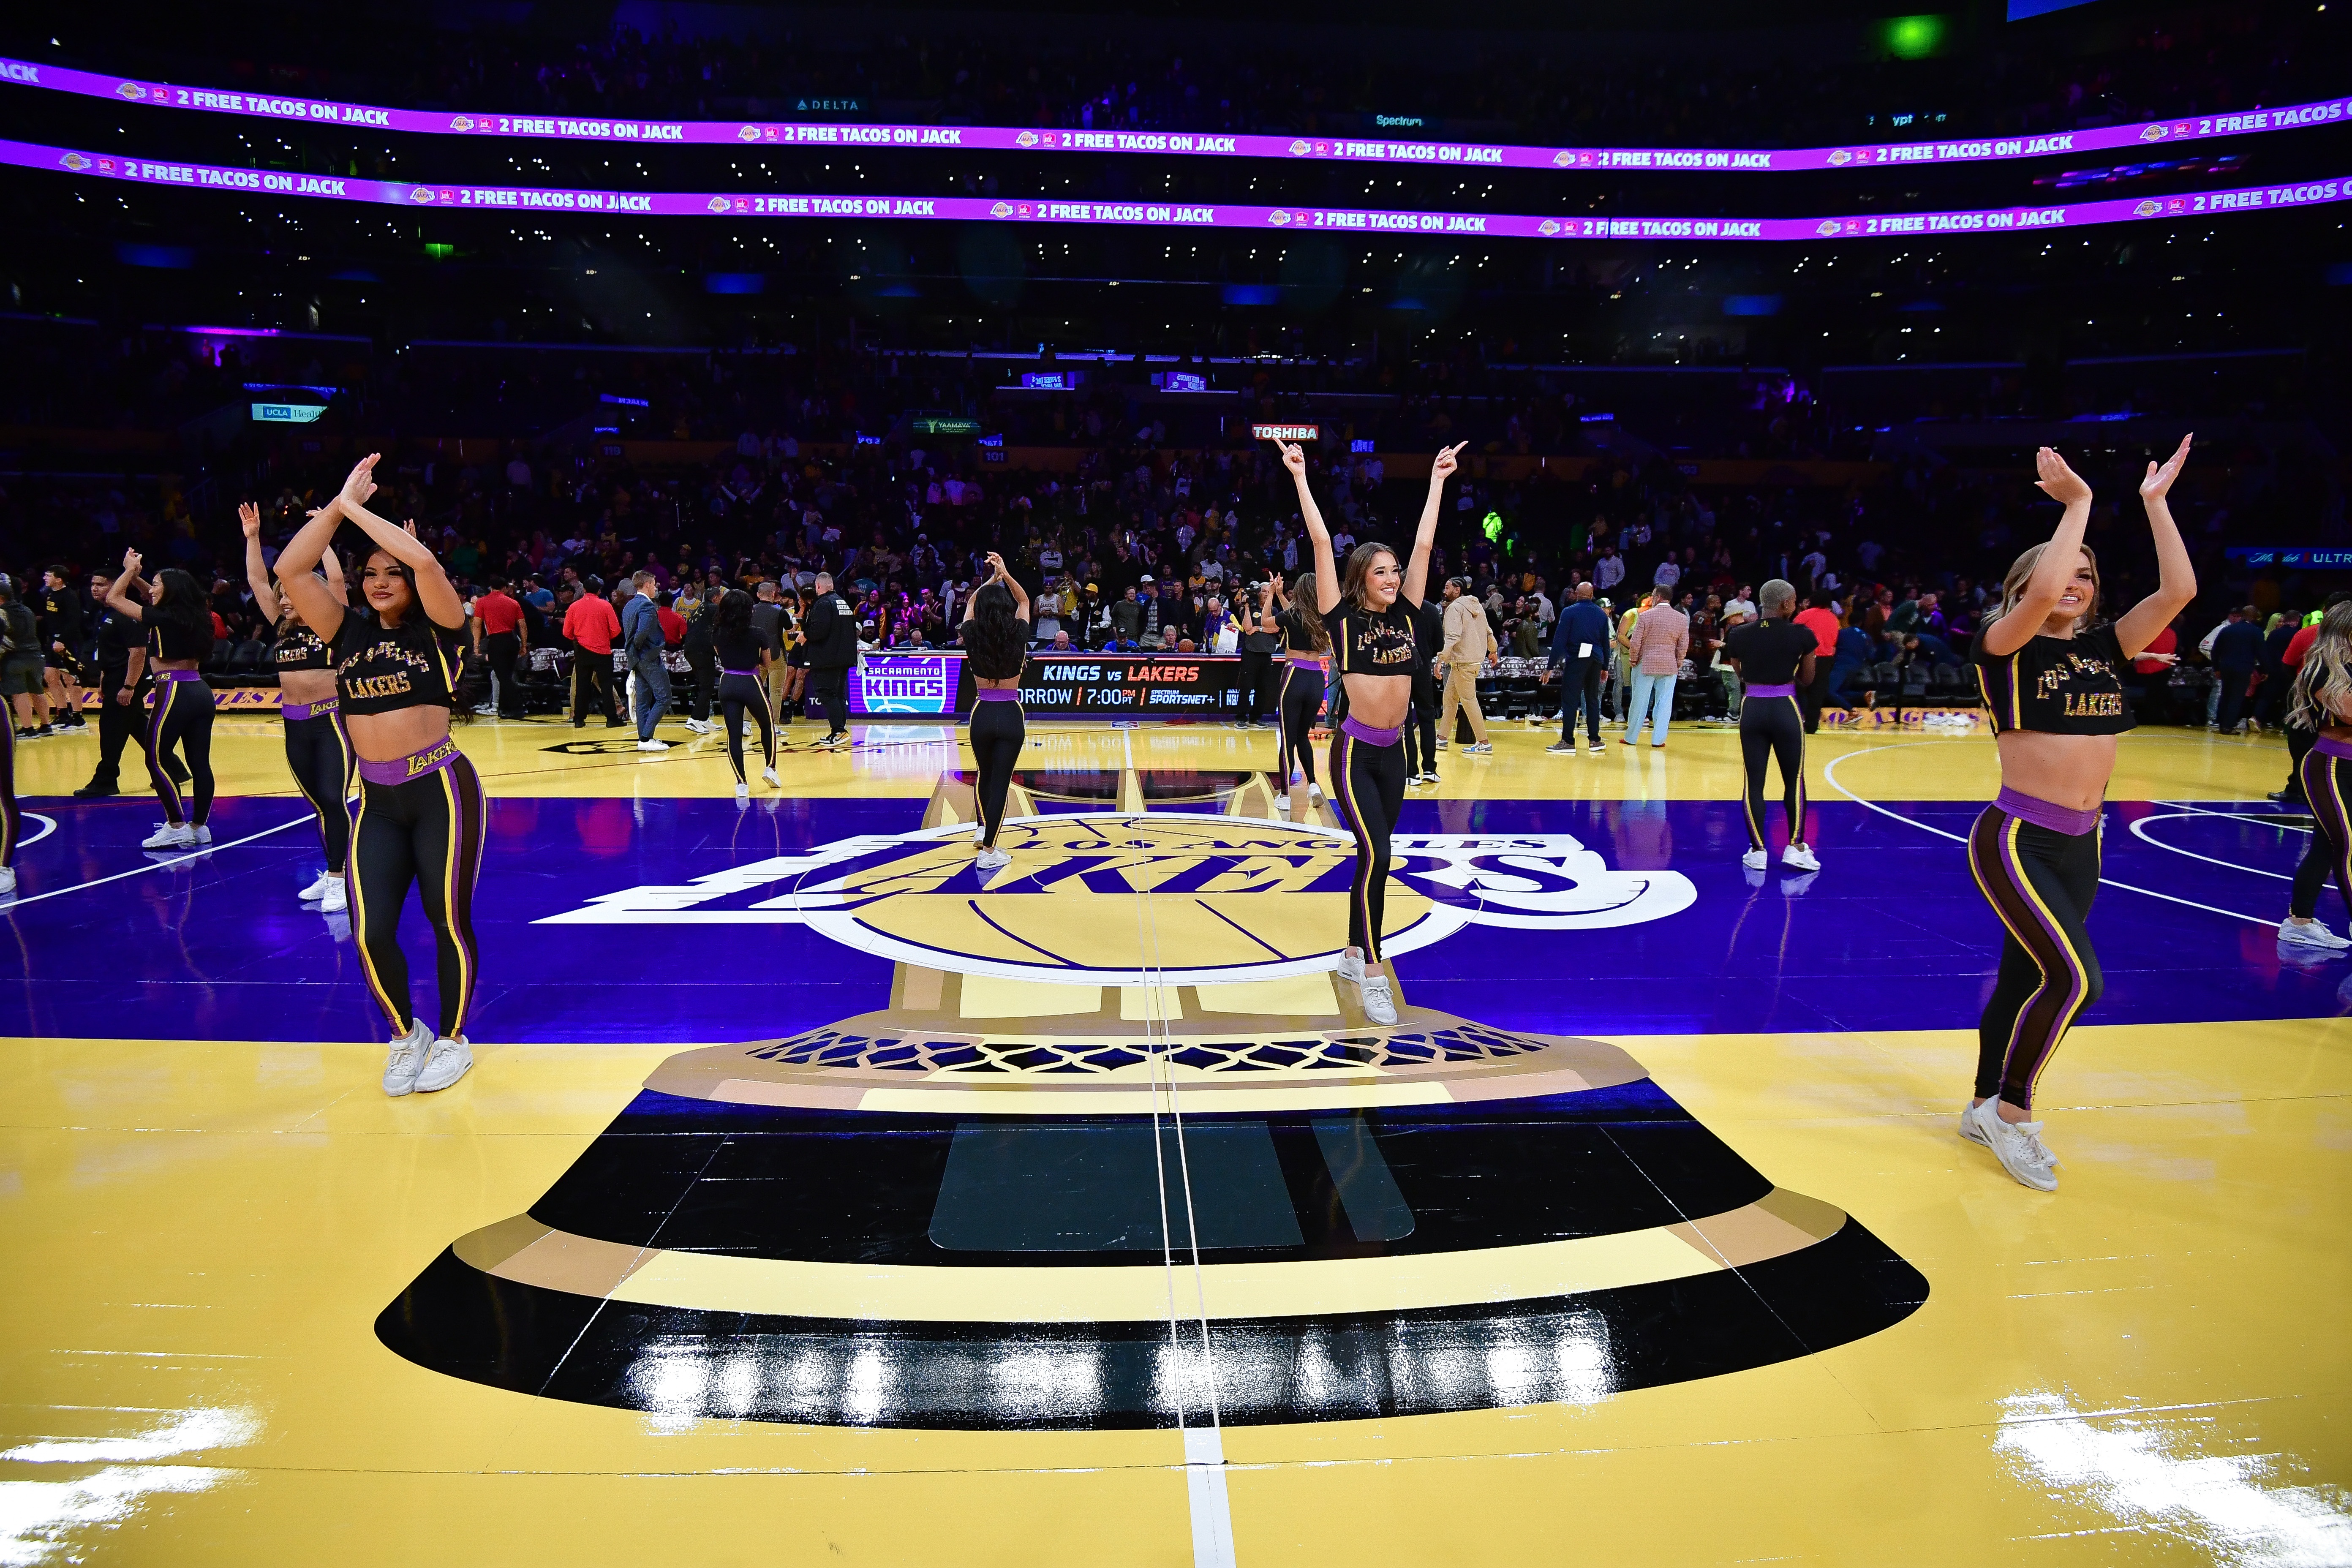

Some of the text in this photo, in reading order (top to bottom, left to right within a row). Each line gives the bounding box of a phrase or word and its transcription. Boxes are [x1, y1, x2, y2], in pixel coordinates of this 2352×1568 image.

[177, 90, 189, 105] 2
[193, 91, 242, 110] FREE
[245, 97, 306, 117] TACOS
[310, 104, 338, 120] ON
[342, 107, 389, 125] JACK
[813, 101, 858, 110] DELTA
[1377, 114, 1422, 127] Spectrum
[2199, 120, 2211, 134] 2
[2215, 113, 2268, 133] FREE
[2272, 103, 2341, 126] TACOS
[499, 118, 509, 132] 2
[513, 118, 555, 134] FREE
[558, 120, 611, 136] TACOS
[614, 123, 638, 138] ON
[642, 125, 683, 139] JACK
[784, 126, 794, 141] 2
[798, 126, 838, 142] FREE
[840, 128, 891, 143] TACOS
[893, 128, 917, 143] ON
[920, 129, 961, 144] JACK
[1062, 133, 1072, 147] 2
[1075, 133, 1114, 148] FREE
[1116, 134, 1167, 150] TACOS
[1169, 136, 1192, 151] ON
[1195, 137, 1236, 152] JACK
[1876, 148, 1887, 162] 2
[1890, 145, 1934, 161] FREE
[1936, 142, 1992, 158] TACOS
[1994, 141, 2022, 156] ON
[2024, 135, 2073, 154] JACK
[1334, 142, 1344, 156] 2
[1346, 142, 1385, 158] FREE
[1387, 144, 1436, 160] TACOS
[1438, 146, 1461, 161] ON
[1463, 147, 1503, 163] JACK
[1598, 152, 1609, 166] 2
[1612, 152, 1651, 166] FREE
[1653, 152, 1703, 167] TACOS
[1705, 153, 1729, 167] ON
[1730, 153, 1771, 168] JACK
[125, 162, 138, 177] 2
[142, 163, 194, 182] FREE
[196, 169, 260, 188] TACOS
[264, 175, 293, 191] ON
[297, 178, 346, 196] JACK
[460, 190, 471, 204] 2
[474, 190, 517, 205] FREE
[520, 191, 574, 207] TACOS
[577, 194, 603, 209] ON
[606, 195, 651, 211] JACK
[2193, 196, 2205, 211] 2
[2210, 191, 2263, 209] FREE
[2268, 183, 2337, 204] TACOS
[754, 198, 765, 212] 2
[768, 198, 809, 213] FREE
[811, 199, 863, 214] TACOS
[866, 200, 890, 214] ON
[893, 200, 935, 215] JACK
[1037, 204, 1047, 218] 2
[1050, 204, 1090, 219] FREE
[1093, 205, 1143, 220] TACOS
[1146, 207, 1170, 221] ON
[1173, 207, 1214, 222] JACK
[1314, 212, 1324, 226] 2
[1326, 212, 1366, 227] FREE
[1368, 214, 1418, 229] TACOS
[1421, 215, 1444, 230] ON
[1446, 216, 1486, 232] JACK
[1583, 221, 1593, 235] 2
[1595, 221, 1639, 235] FREE
[1642, 221, 1691, 236] TACOS
[1694, 222, 1718, 236] ON
[1720, 222, 1761, 237] JACK
[1866, 219, 1878, 233] 2
[1880, 217, 1925, 232] FREE
[1927, 214, 1984, 230] TACOS
[1986, 213, 2013, 228] ON
[2016, 209, 2065, 226] JACK
[254, 408, 275, 416] UCLA
[1252, 427, 1317, 439] TOSHIBA
[985, 452, 1004, 461] 101
[276, 647, 308, 663] LAKERS
[1043, 665, 1101, 681] KINGS
[1127, 666, 1200, 681] LAKERS
[345, 671, 411, 699] LAKERS
[866, 680, 942, 697] KINGS
[1087, 689, 1121, 705] 7:00
[1149, 696, 1215, 705] SPORTSNET+
[1008, 840, 1161, 849] LOS
[608, 839, 1656, 915] LAKERS
